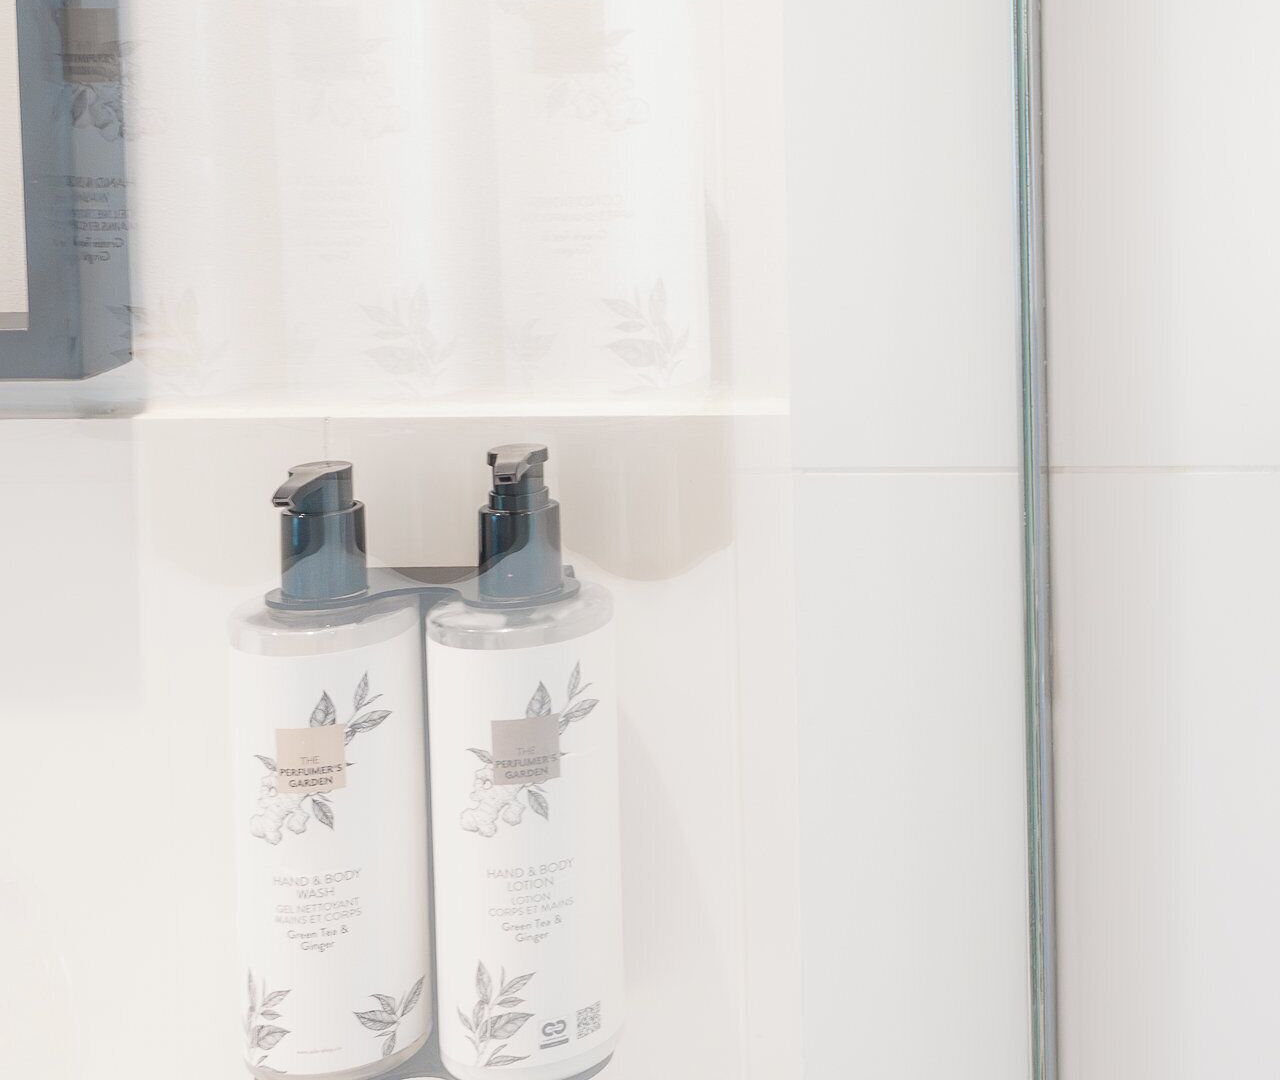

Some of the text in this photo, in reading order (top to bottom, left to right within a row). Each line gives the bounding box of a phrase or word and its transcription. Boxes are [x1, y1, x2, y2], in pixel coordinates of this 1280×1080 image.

[289, 776, 333, 788] GARDEN
[487, 857, 574, 878] HAND & BODY
[273, 868, 361, 887] HAND & BODY
[507, 877, 554, 891] LOTION
[297, 887, 335, 898] WASH
[511, 892, 551, 905] LOTION
[502, 922, 532, 931] Green
[534, 918, 551, 928] Tea
